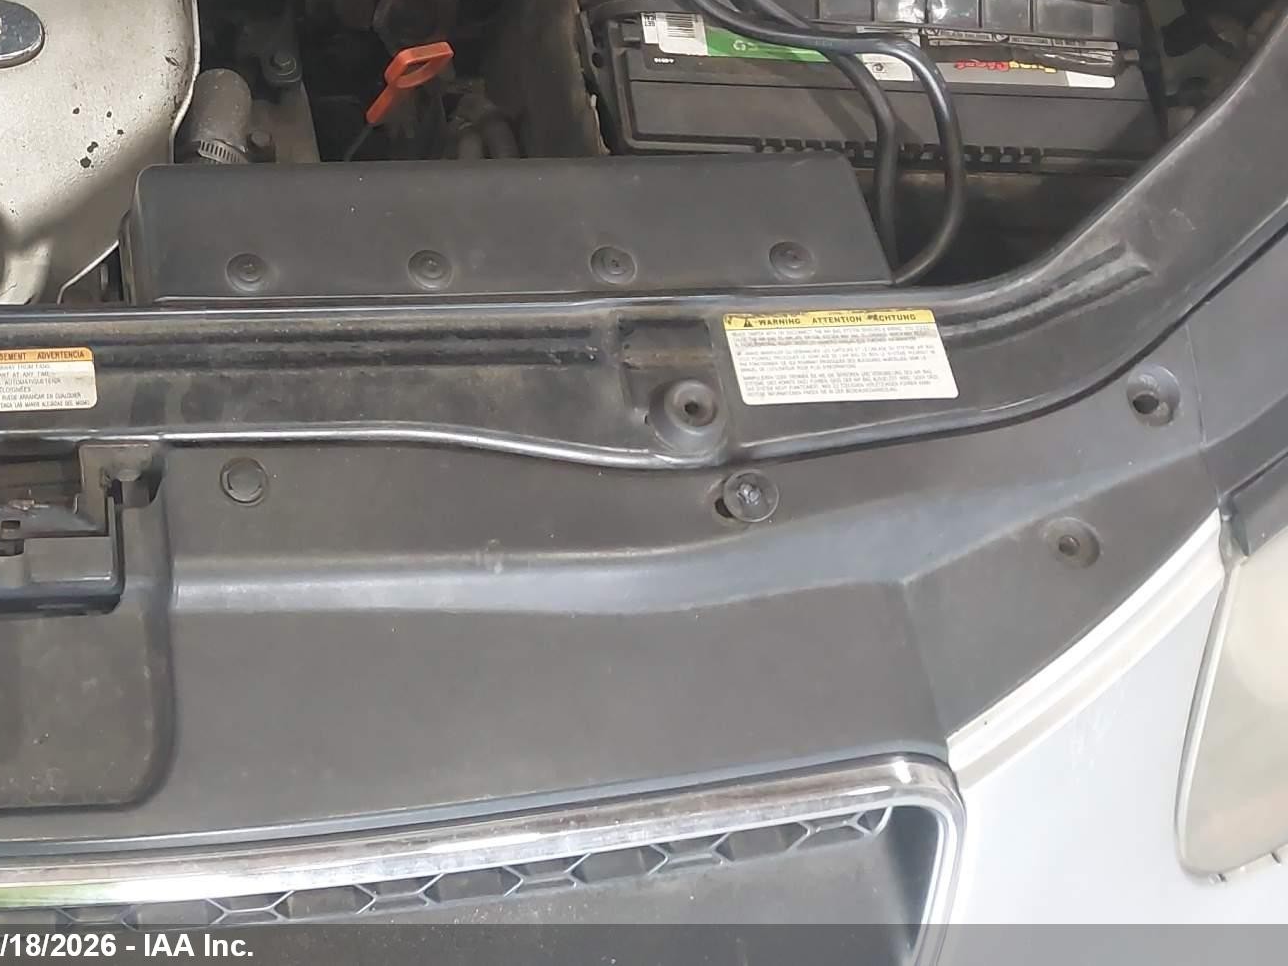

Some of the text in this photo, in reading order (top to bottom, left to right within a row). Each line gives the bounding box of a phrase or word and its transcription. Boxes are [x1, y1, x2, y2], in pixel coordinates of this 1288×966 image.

[759, 318, 801, 326] WARNING
[812, 316, 862, 324] ATTENTION
[37, 351, 85, 360] ADVERTENCIA
